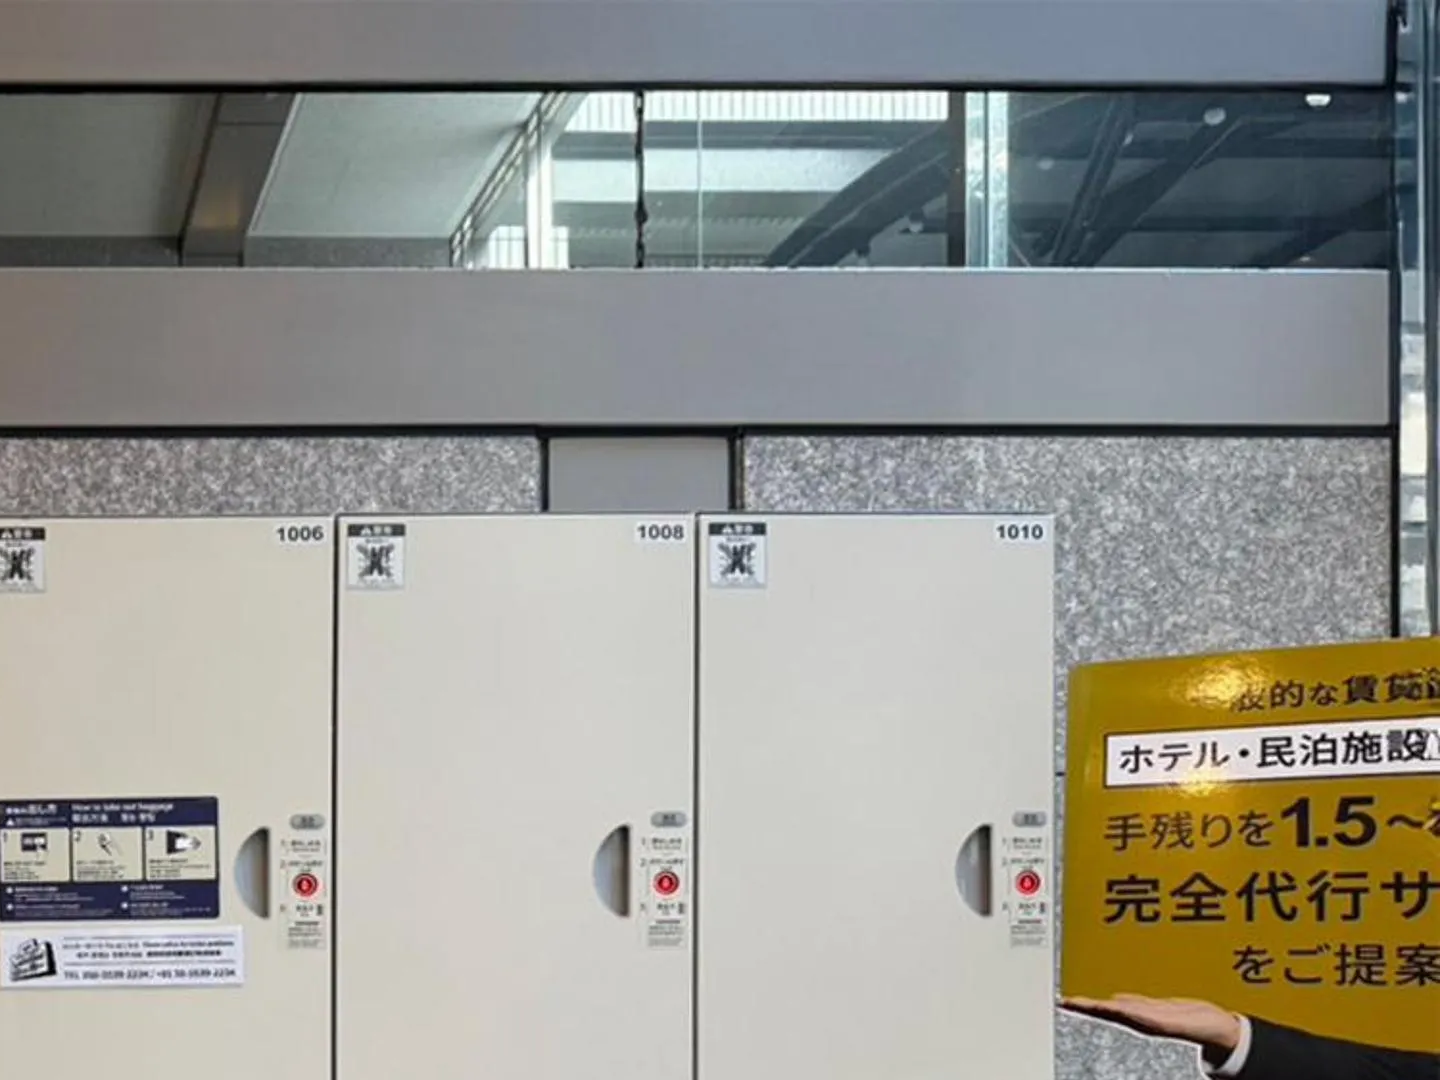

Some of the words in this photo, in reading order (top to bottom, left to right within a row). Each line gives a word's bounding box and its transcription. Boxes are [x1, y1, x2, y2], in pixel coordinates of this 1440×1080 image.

[277, 525, 324, 541] 1006
[637, 524, 685, 540] 1008
[997, 524, 1044, 540] 1010
[1104, 870, 1440, 925] 完全代行サ
[1233, 942, 1440, 986] をご提案
